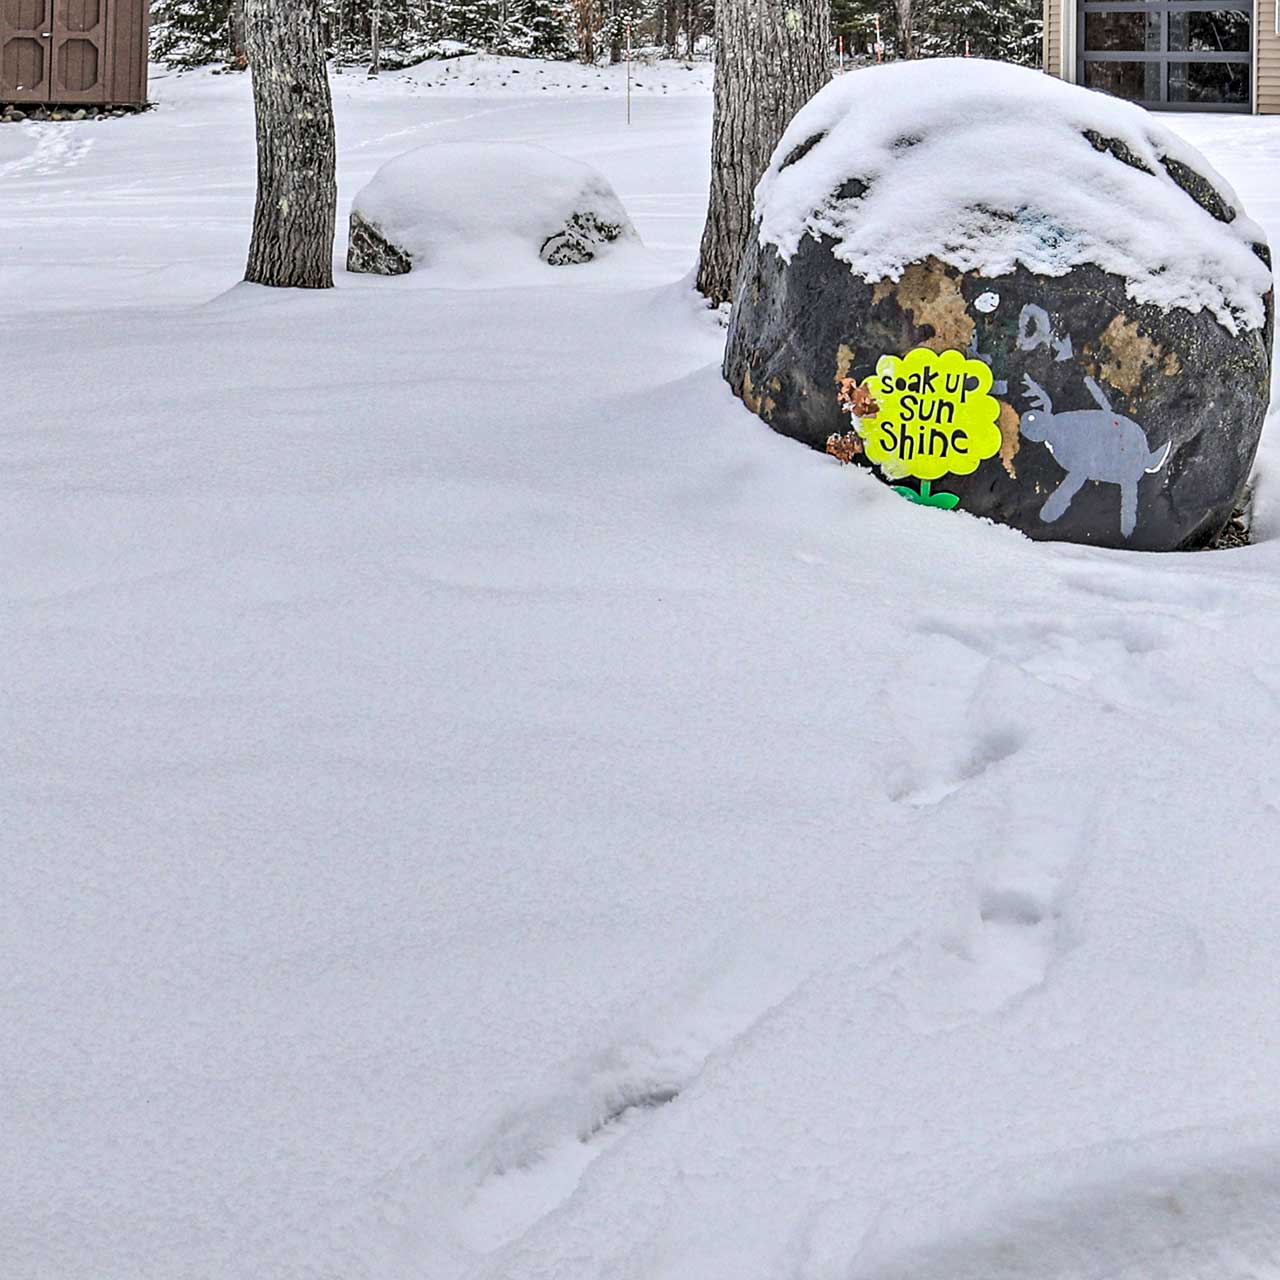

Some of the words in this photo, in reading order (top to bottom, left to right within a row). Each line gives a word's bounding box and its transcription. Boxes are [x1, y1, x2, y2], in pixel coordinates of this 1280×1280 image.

[880, 366, 939, 394] soak
[946, 372, 980, 403] up
[880, 421, 968, 460] Shine
